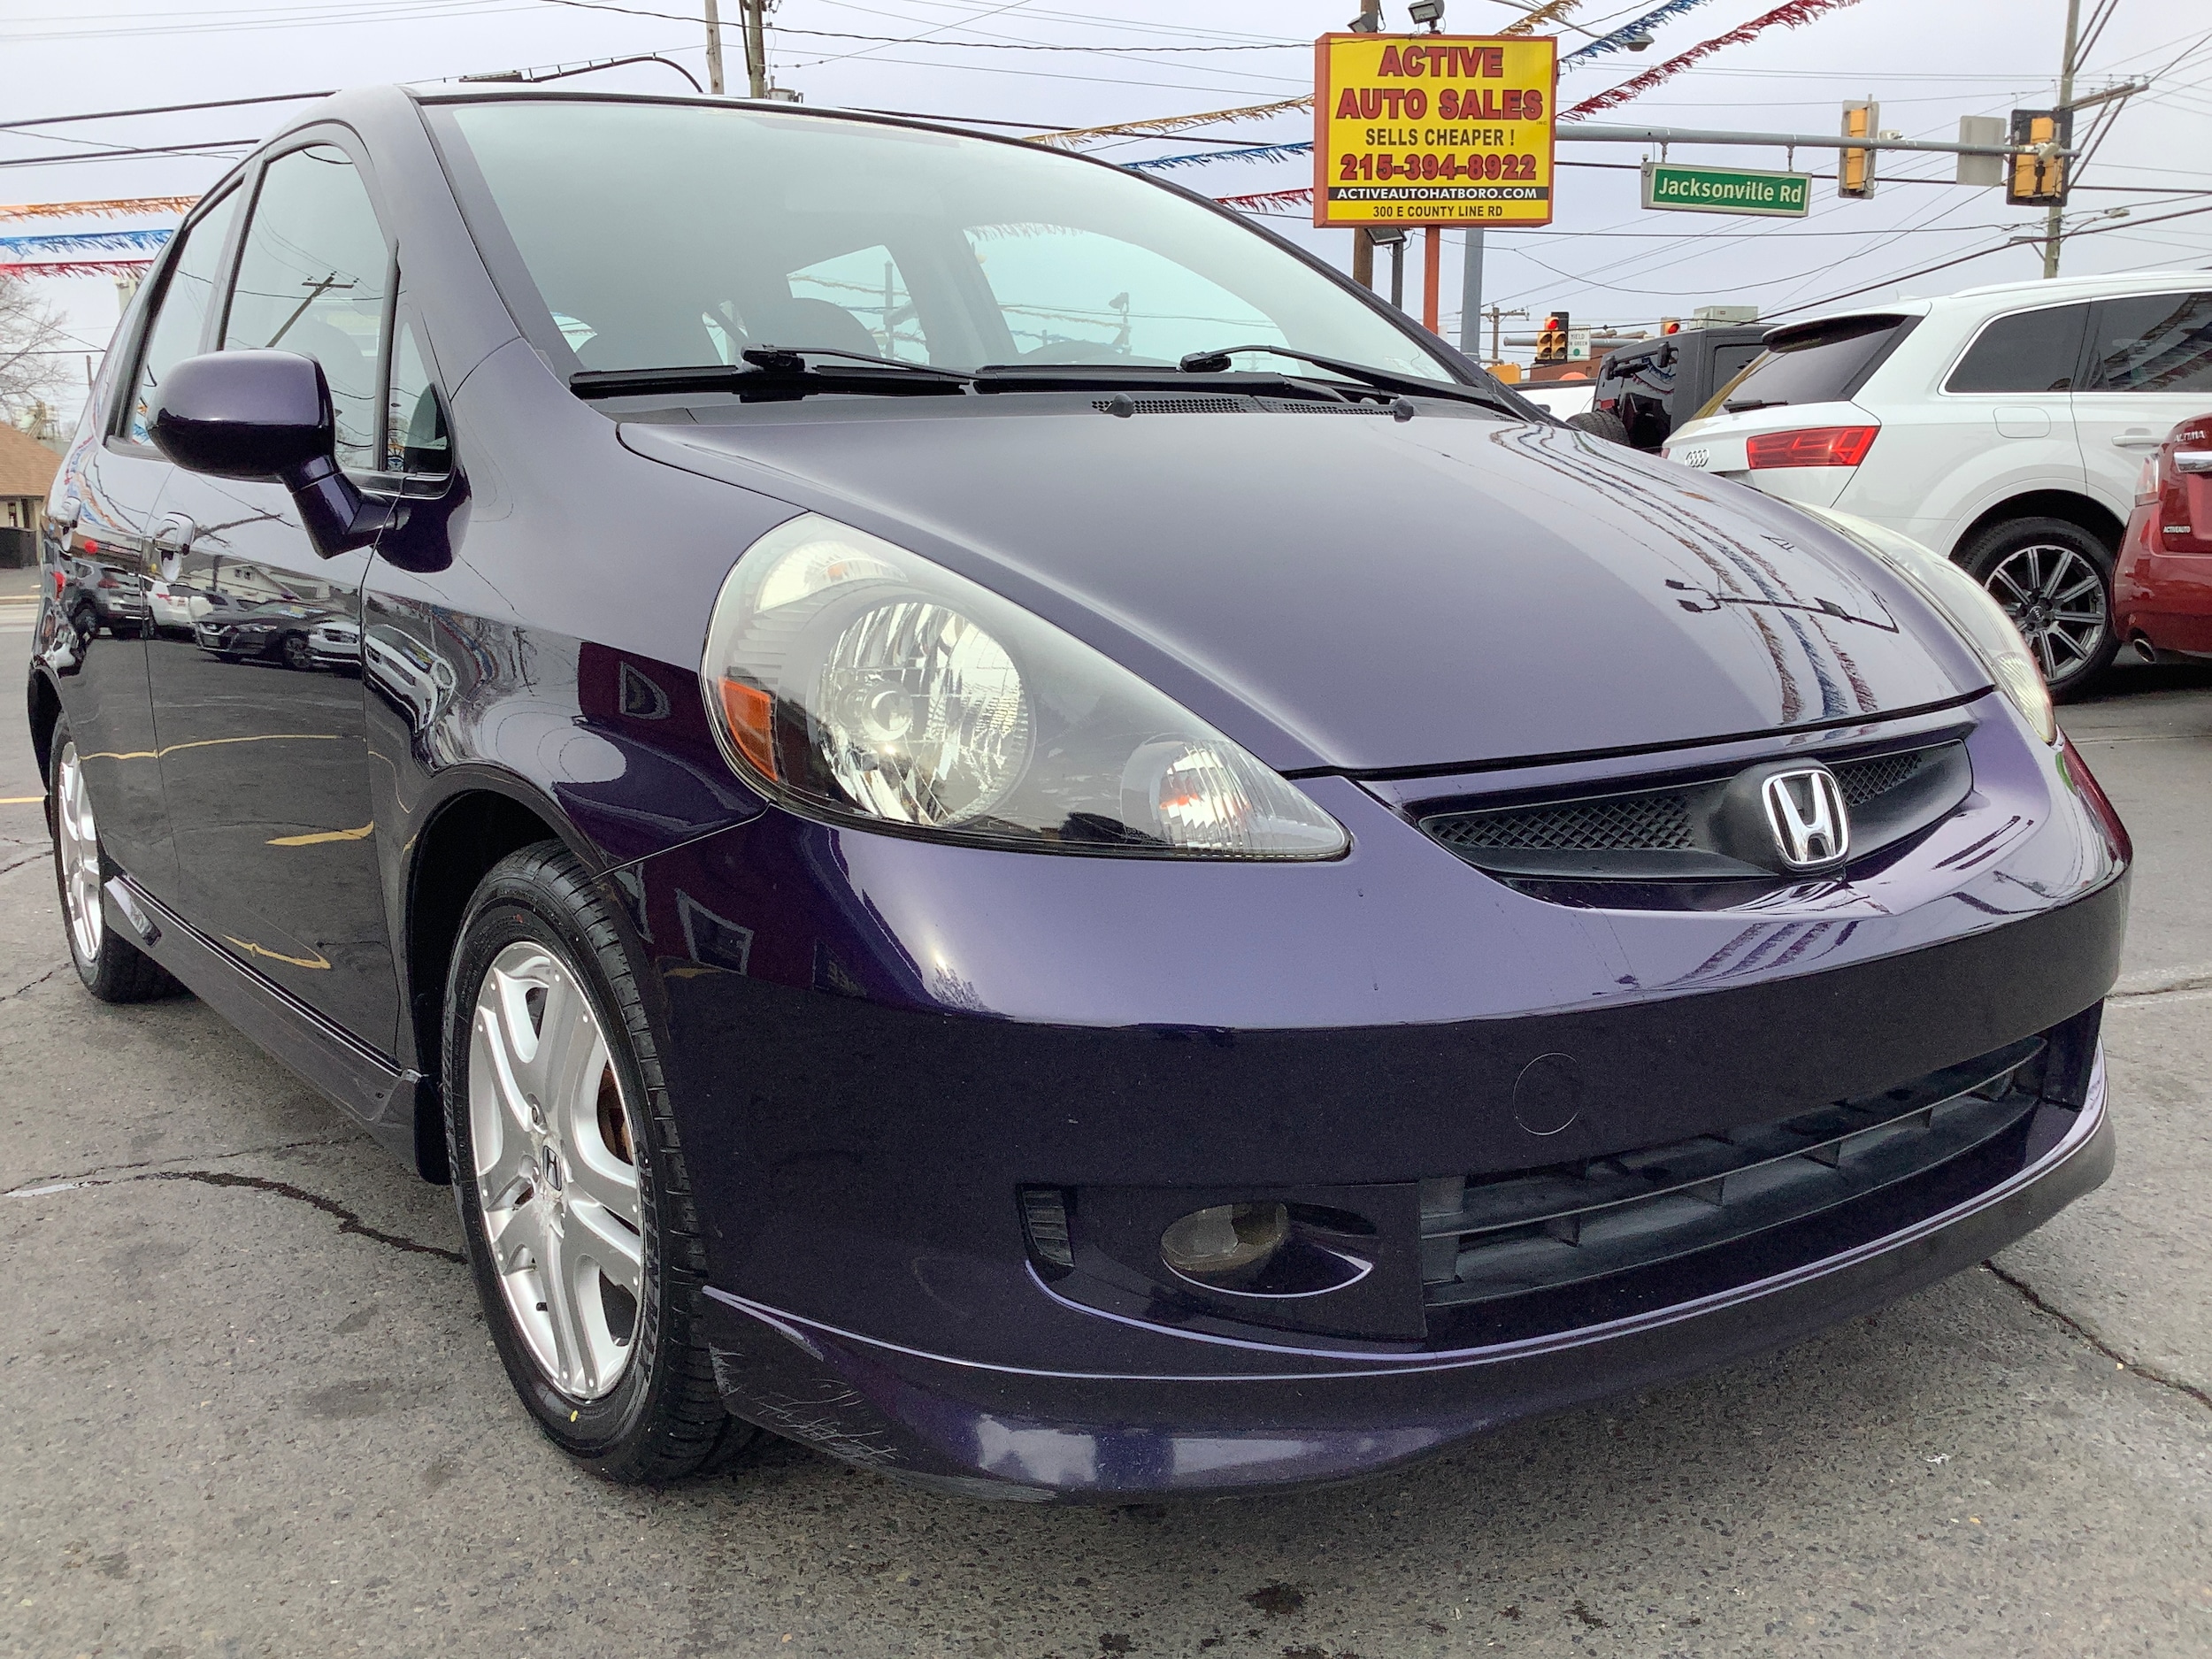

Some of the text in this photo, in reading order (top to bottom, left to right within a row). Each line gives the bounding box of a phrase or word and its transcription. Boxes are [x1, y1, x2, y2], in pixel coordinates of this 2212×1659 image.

[1378, 45, 1503, 78] ACTIVE
[1335, 88, 1543, 120] AUTO SALES
[1365, 128, 1417, 146] SELLS
[1425, 128, 1504, 146] CHEAPER
[1340, 153, 1537, 180] 215-394-8922
[1337, 188, 1537, 200] ACTIVEAUTOHATBORO.COM
[1658, 177, 1802, 204] Jacksonville Rd
[1372, 205, 1502, 217] 300 E COUNTY LINE RD
